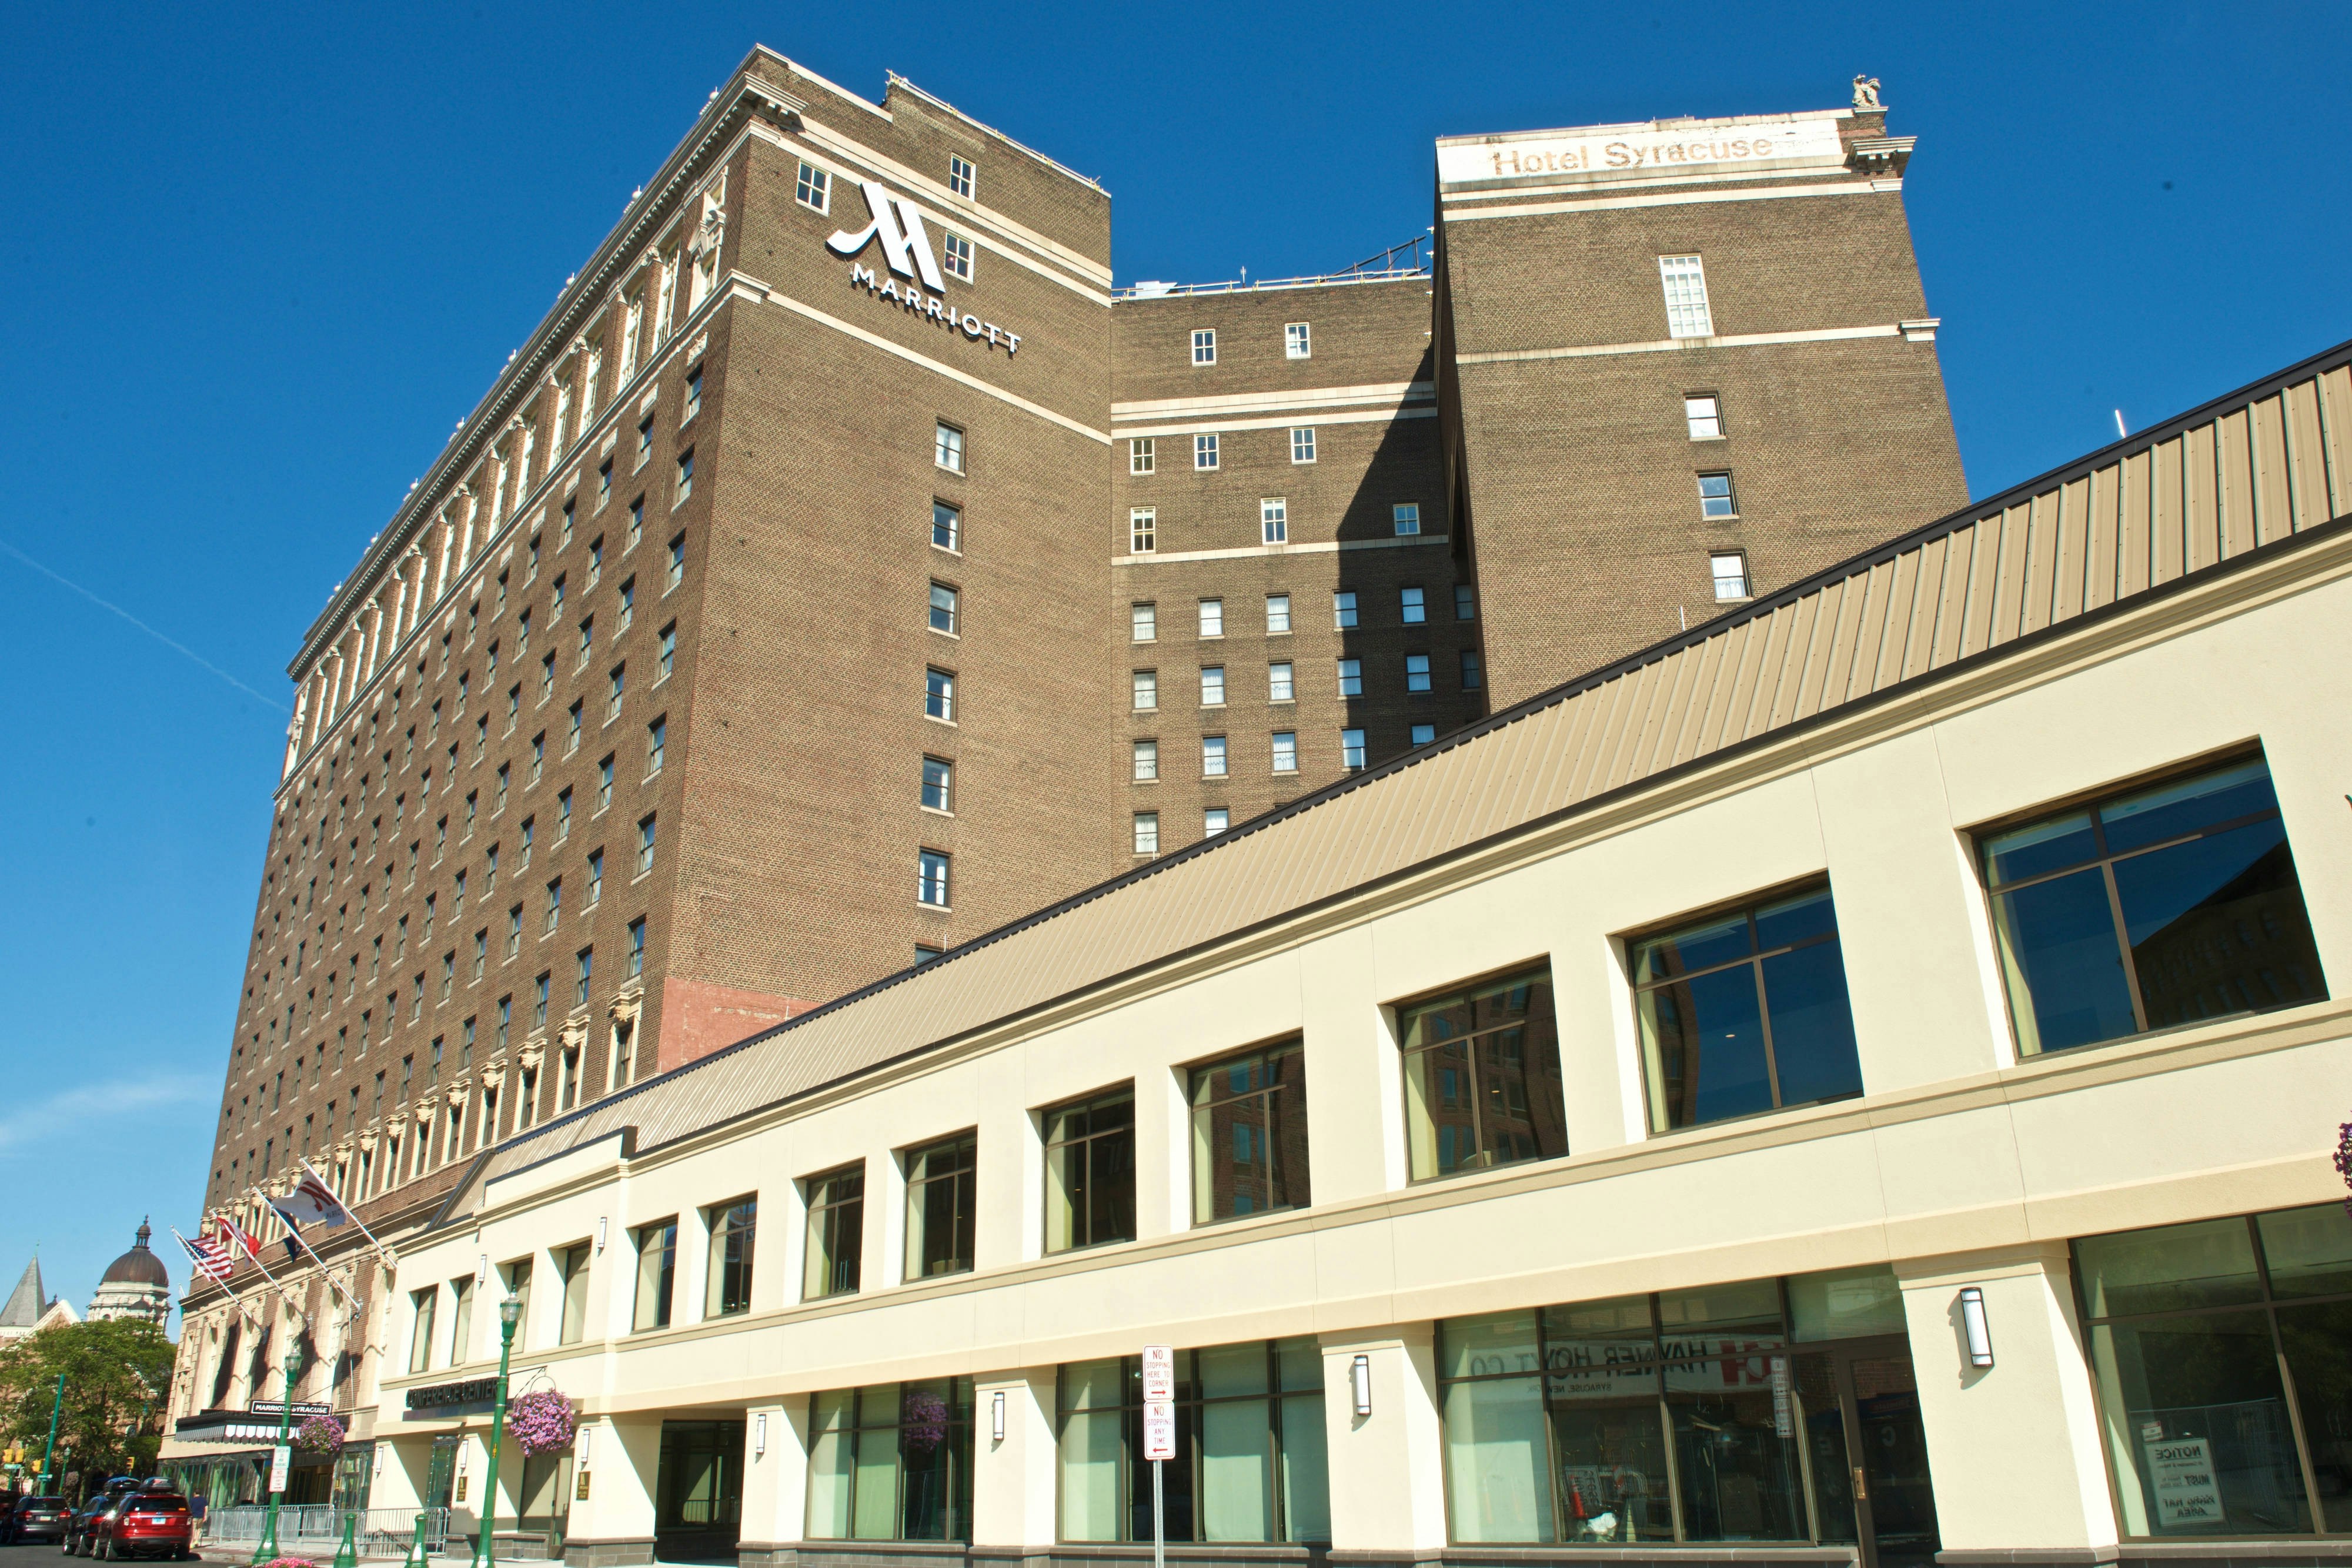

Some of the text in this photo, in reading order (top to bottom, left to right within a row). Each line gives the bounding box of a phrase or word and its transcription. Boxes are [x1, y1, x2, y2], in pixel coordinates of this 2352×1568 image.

[1492, 138, 1773, 175] Hotel Syracuse
[852, 262, 1021, 353] MARRIOTT
[1152, 1349, 1163, 1359] NO
[406, 1377, 499, 1409] CONFERENCE CENTER
[1154, 1406, 1164, 1416] NO
